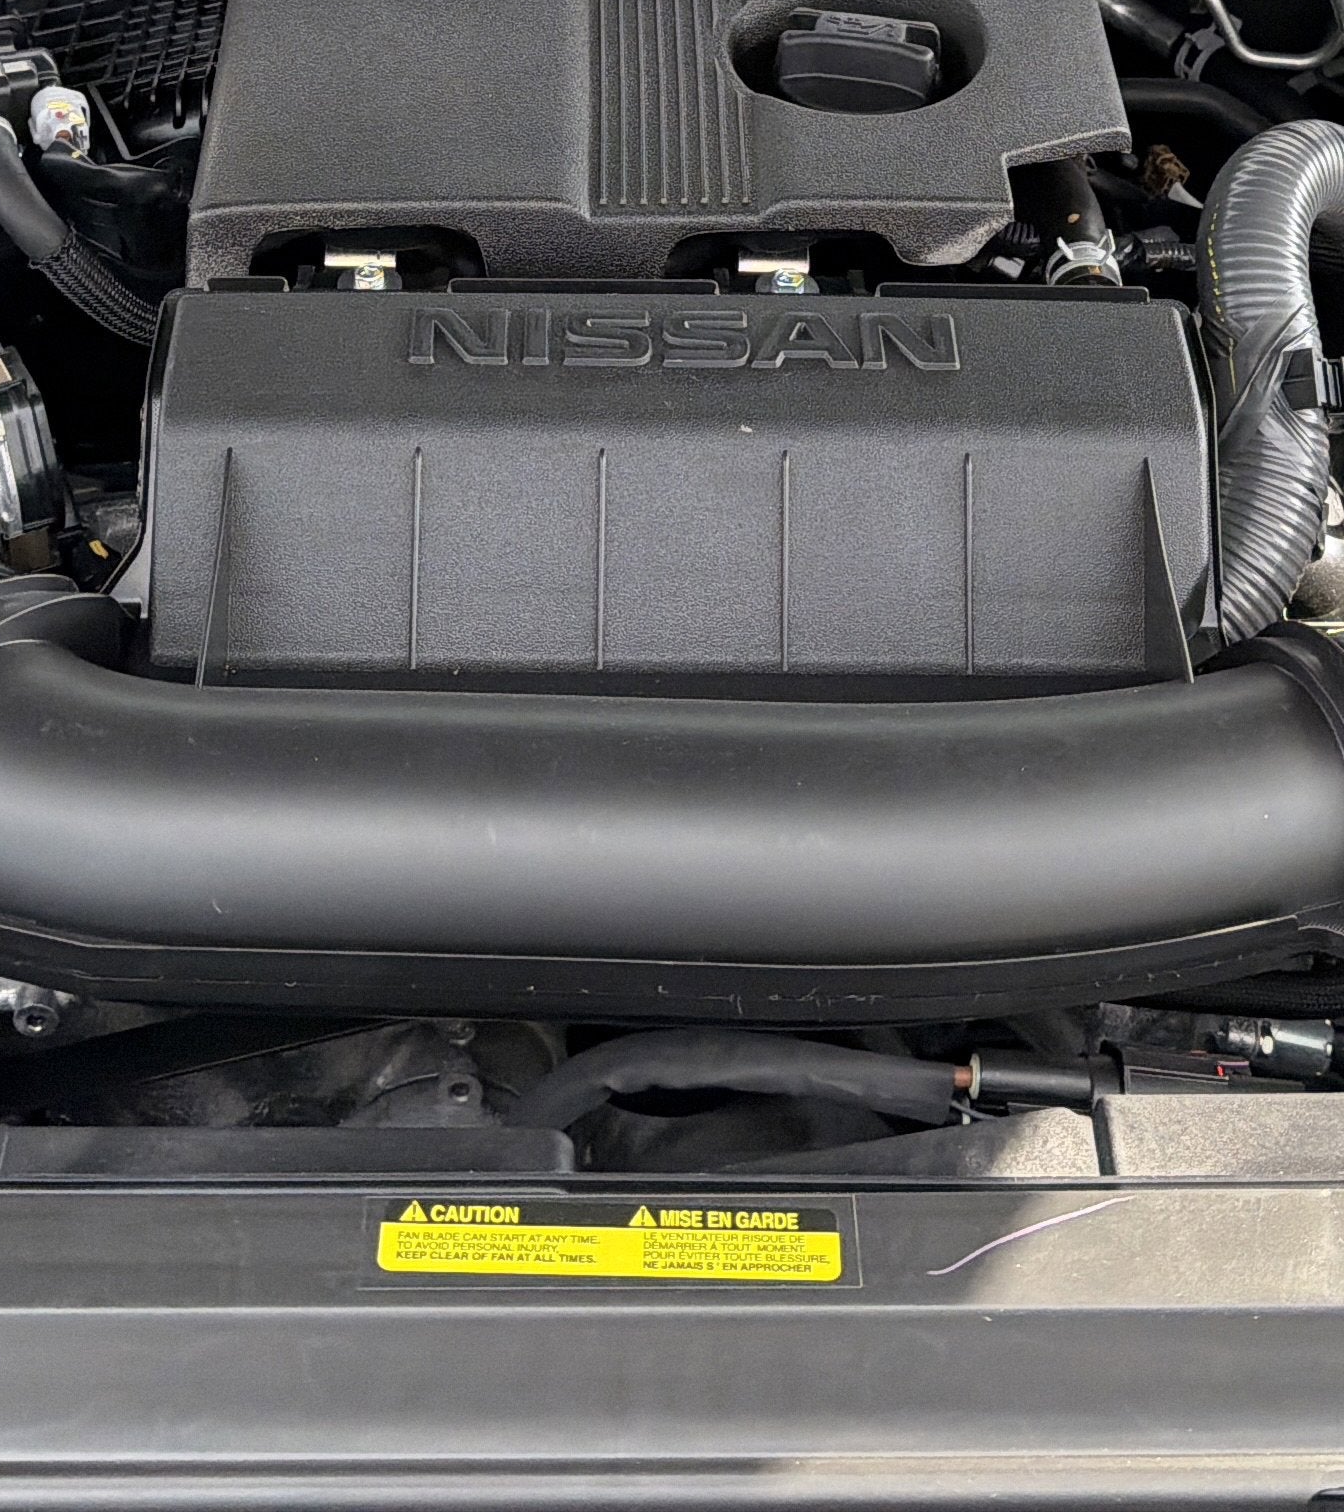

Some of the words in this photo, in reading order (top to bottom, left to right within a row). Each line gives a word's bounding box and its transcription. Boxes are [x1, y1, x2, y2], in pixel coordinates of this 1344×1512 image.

[408, 308, 960, 371] NISSAN
[430, 1204, 520, 1223] CAUTION
[660, 1210, 703, 1228] MISE
[708, 1210, 732, 1228] EN
[735, 1211, 799, 1230] GARDE
[398, 1231, 420, 1240] FAN
[423, 1232, 460, 1241] BLADE
[463, 1233, 487, 1242] CAN
[491, 1234, 525, 1242] START
[545, 1235, 567, 1243] ANY
[643, 1232, 657, 1240] LE
[662, 1233, 738, 1242] VENTILATEUR
[742, 1234, 786, 1243] RISQUE
[789, 1235, 805, 1243] DE
[398, 1241, 412, 1250] TO
[415, 1242, 449, 1250] AVOID
[453, 1243, 514, 1252] PERSONAL
[721, 1244, 751, 1252] TOUT
[396, 1251, 427, 1259] KEEP
[431, 1251, 469, 1260] CLEAR
[473, 1252, 488, 1260] OF
[491, 1253, 514, 1261] FAN
[517, 1253, 530, 1262] AT
[533, 1253, 556, 1262] ALL
[643, 1251, 675, 1259] POUR
[724, 1253, 762, 1262] TOUTE
[643, 1261, 659, 1269] NE
[662, 1261, 703, 1270] JAMAIS
[741, 1263, 811, 1272] APPROCHER
